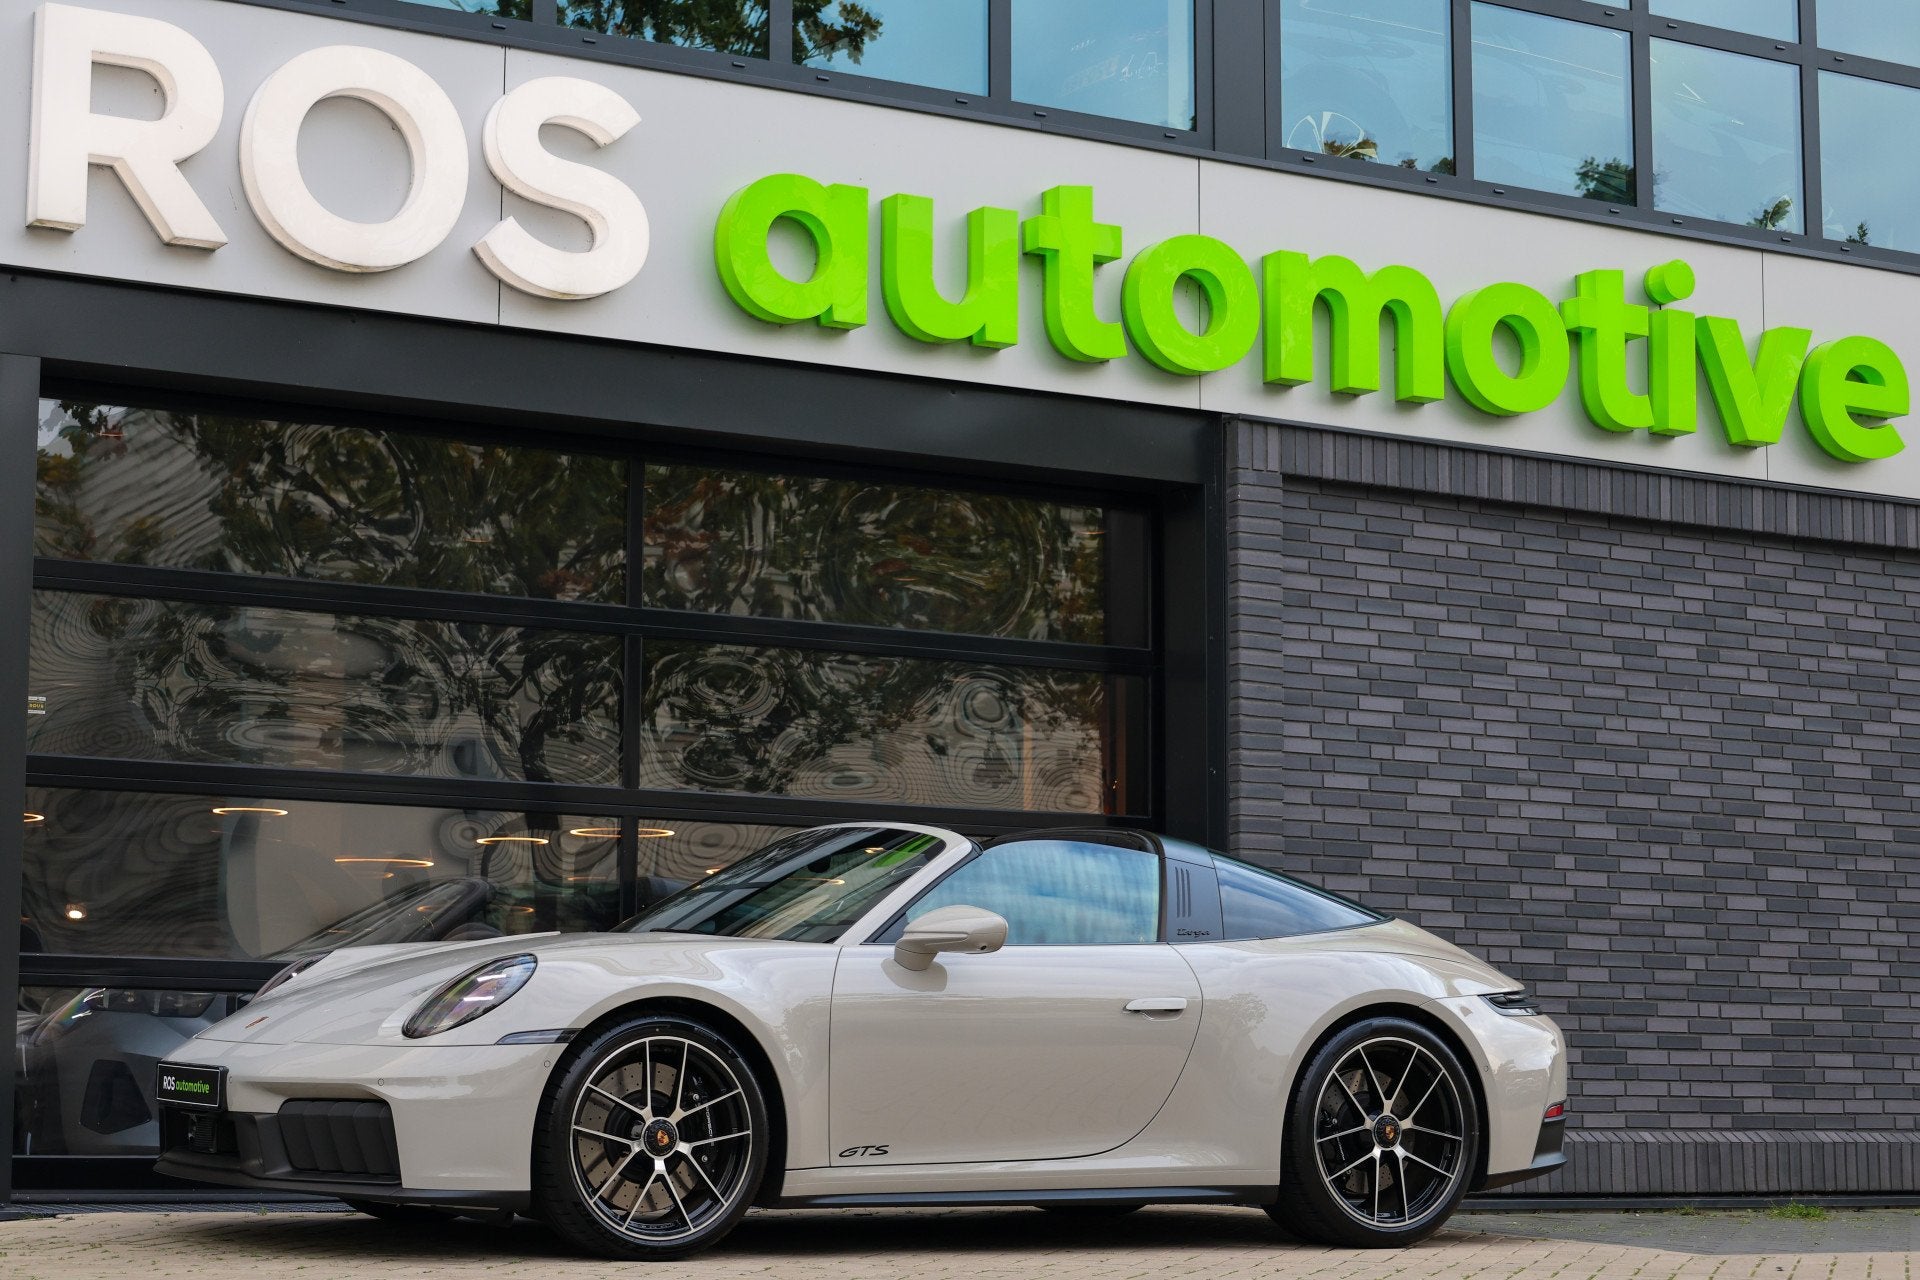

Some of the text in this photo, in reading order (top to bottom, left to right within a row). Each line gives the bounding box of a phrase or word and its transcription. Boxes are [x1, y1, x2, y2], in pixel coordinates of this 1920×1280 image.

[26, 1, 1909, 464] ROS automotive
[163, 1076, 209, 1093] ROS automotive
[839, 1145, 889, 1157] GTS
